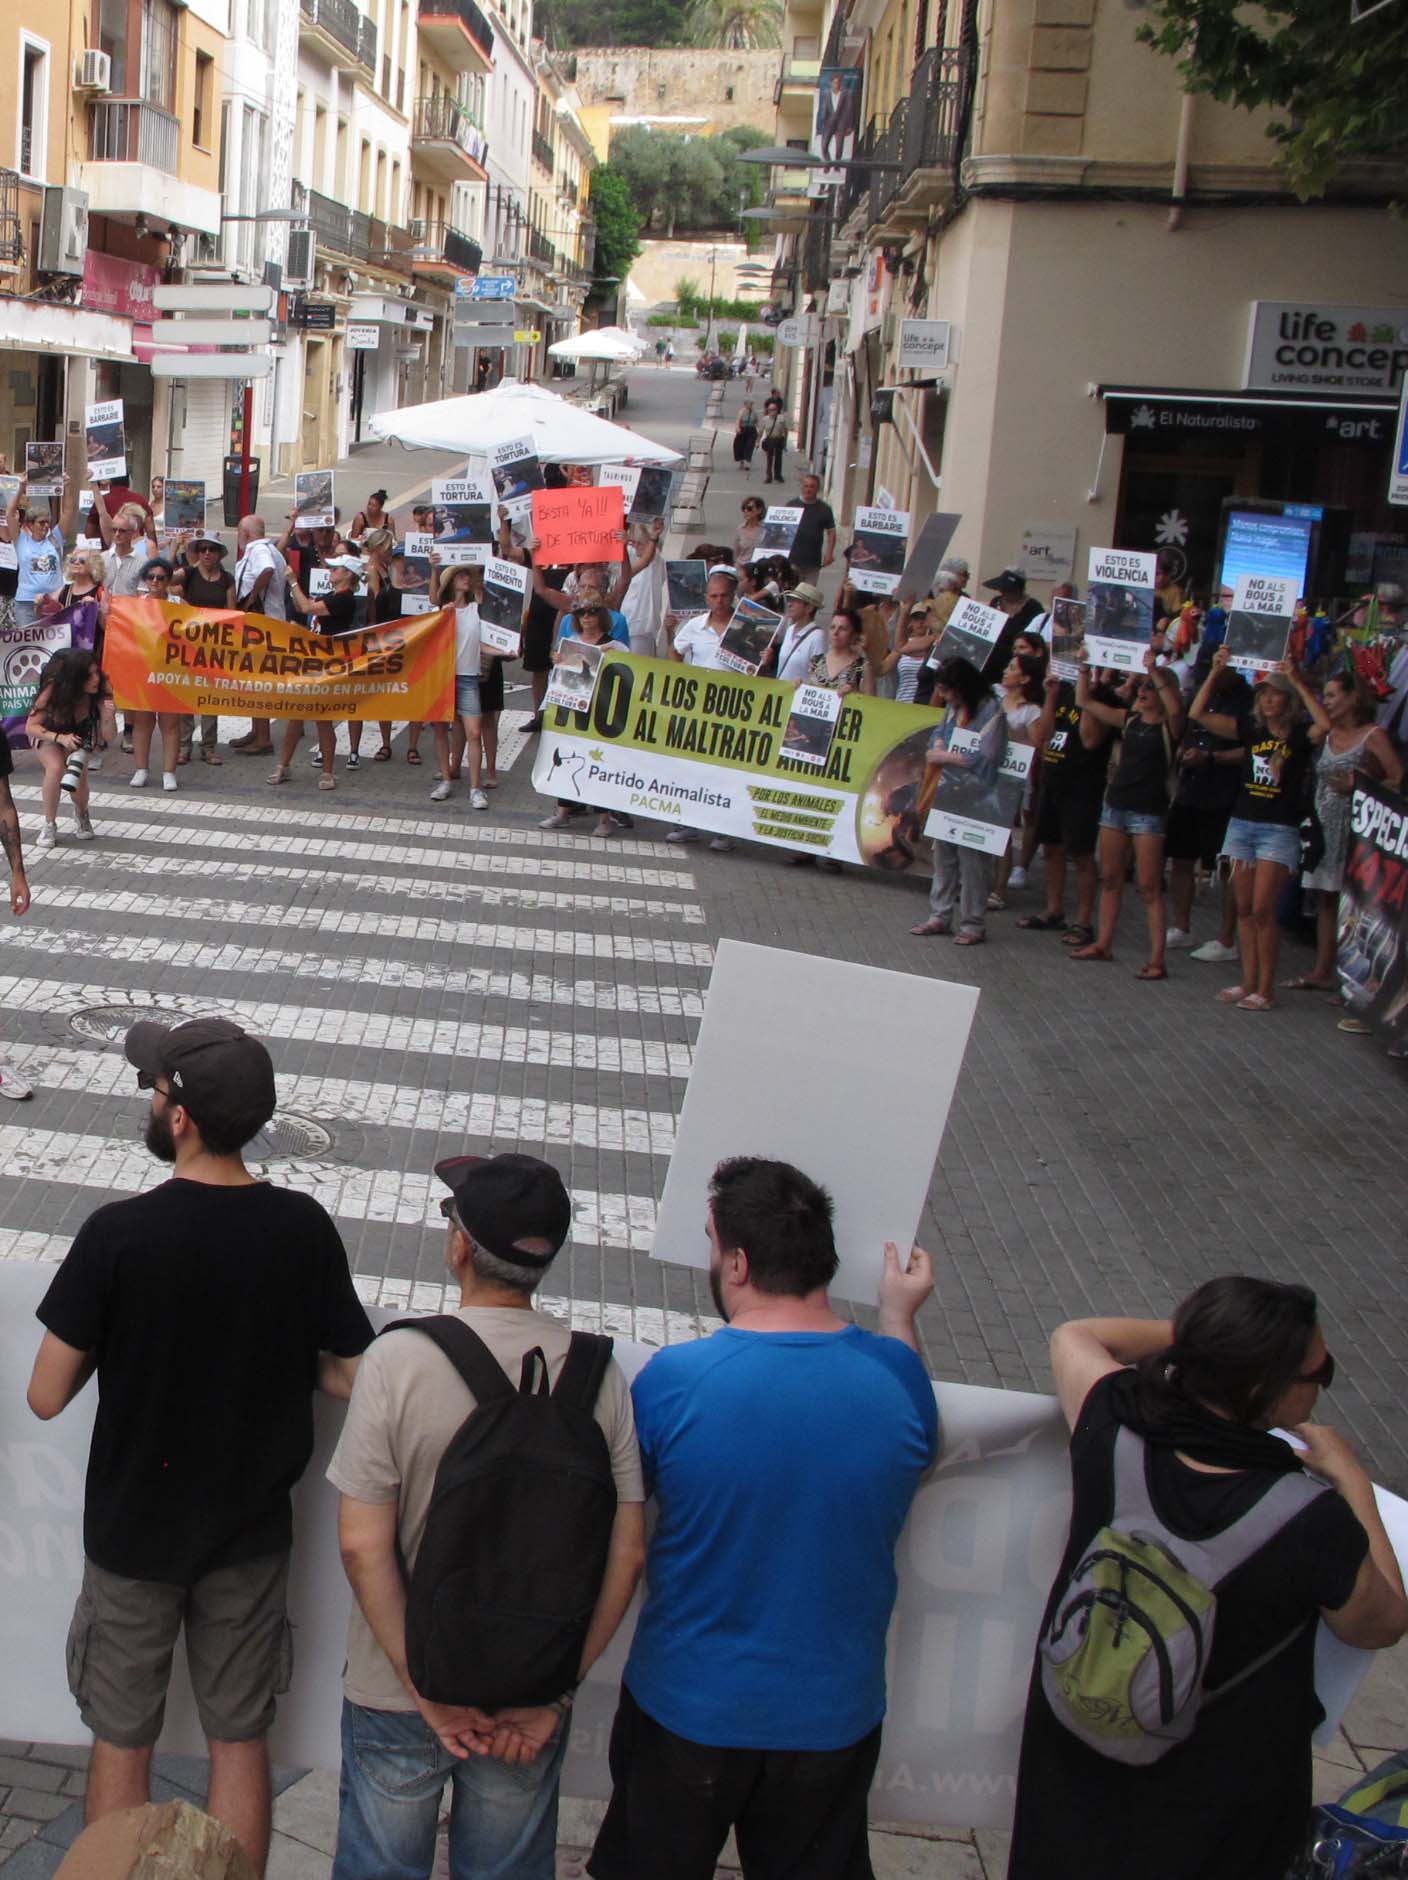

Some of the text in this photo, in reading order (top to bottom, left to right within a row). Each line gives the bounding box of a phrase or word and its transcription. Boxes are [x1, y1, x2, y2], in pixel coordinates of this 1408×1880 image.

[1279, 312, 1336, 341] life
[1272, 373, 1385, 387] LIVING SHOE STORE
[1159, 411, 1172, 424] El
[1339, 418, 1381, 439] art
[494, 447, 531, 464] TORTURA
[446, 483, 477, 491] ESTO ES
[440, 491, 483, 501] TORTURA
[860, 519, 903, 533] BARBARIE
[1105, 555, 1141, 568] ESTO ES
[487, 568, 522, 588] TORMENTO
[1095, 566, 1149, 582] VIOLENCIA
[1249, 578, 1286, 592] NO ALS
[1245, 589, 1275, 601] BOUS
[966, 602, 979, 614] NO
[1243, 602, 1283, 614] LA MAR
[961, 611, 986, 627] BOUS
[957, 619, 990, 639] LA MAR
[169, 618, 407, 657] COME PLANTAS
[165, 642, 405, 678] PLANTA ARBOLES
[147, 671, 408, 696] APOYA EL TRATADO BASADO EN PLANTAS
[639, 671, 654, 703] A
[660, 674, 699, 711] LOS
[702, 682, 753, 722] BOUS
[758, 694, 784, 728] AL
[804, 688, 833, 702] NO ALS
[197, 693, 358, 714] plantbasedtreaty.org
[799, 704, 829, 718] LA MAR
[801, 697, 822, 710] BOUS
[633, 708, 774, 766] AL MALTRATO
[587, 764, 732, 810] Partido Animalista
[629, 793, 682, 817] PACMA
[772, 791, 789, 803] LOS
[790, 794, 837, 813] ANIMALES
